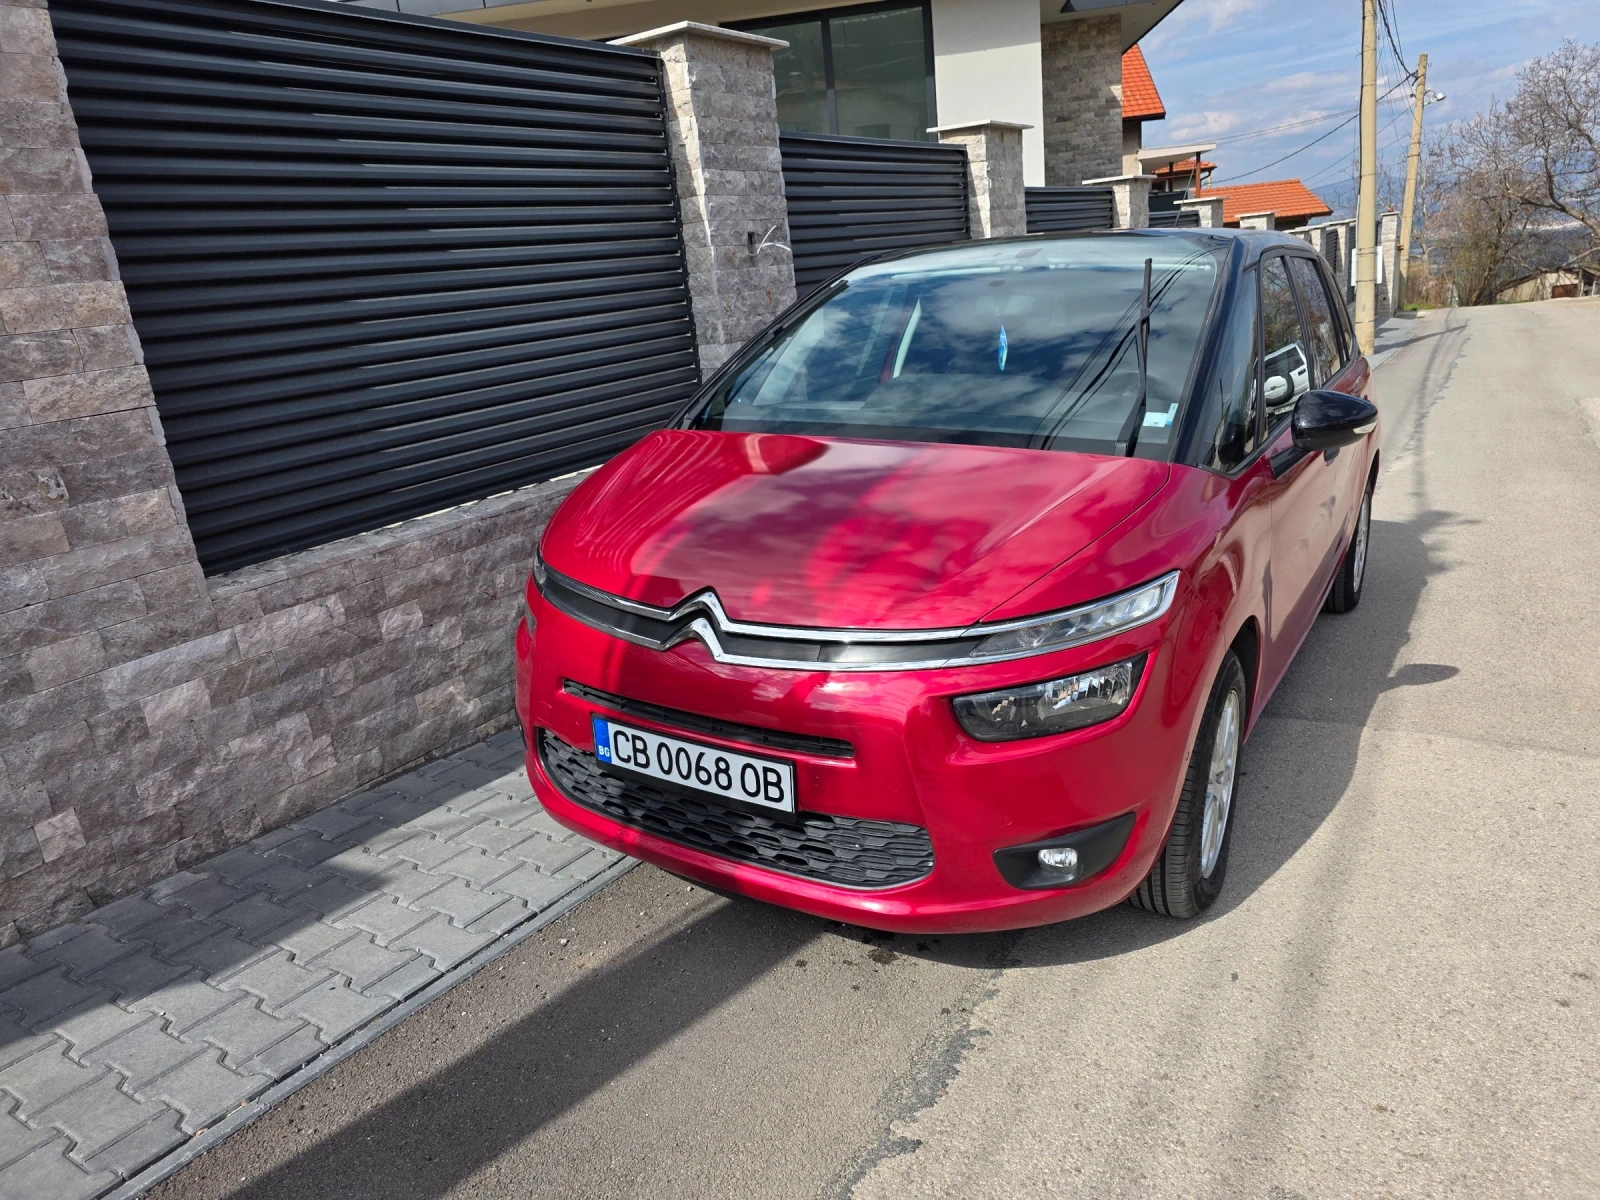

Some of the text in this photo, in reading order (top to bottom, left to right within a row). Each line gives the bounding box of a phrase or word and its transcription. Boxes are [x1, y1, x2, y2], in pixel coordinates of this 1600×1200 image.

[598, 744, 611, 757] BG
[613, 730, 785, 803] CB 0068 OB
